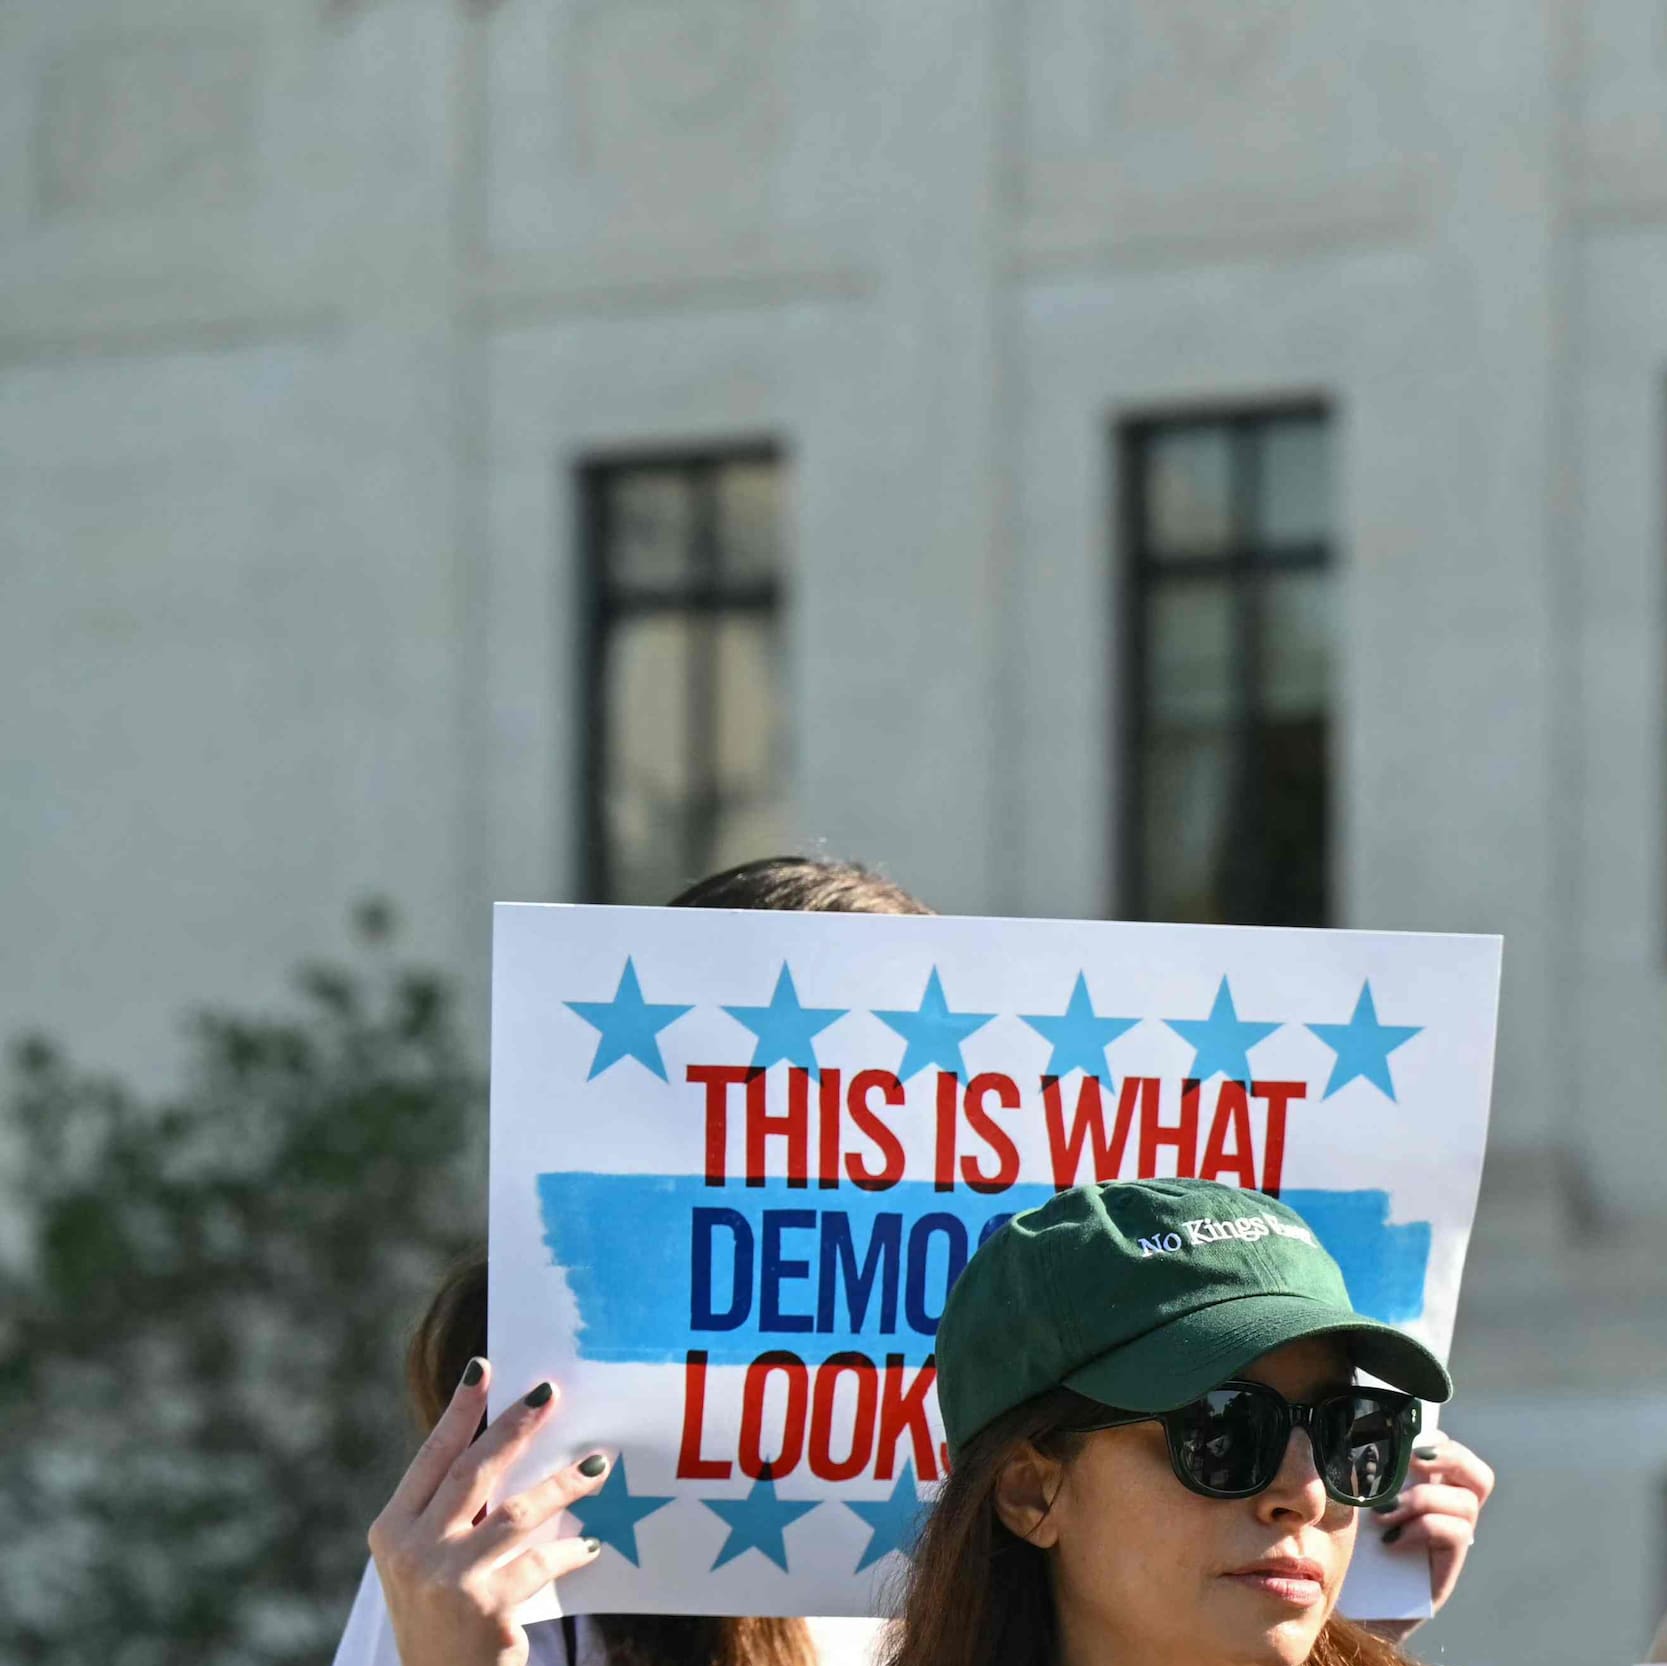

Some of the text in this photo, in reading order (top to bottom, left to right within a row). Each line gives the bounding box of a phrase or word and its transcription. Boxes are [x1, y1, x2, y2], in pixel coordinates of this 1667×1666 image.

[687, 1065, 1307, 1198] THIS IS WHAT
[690, 1207, 1014, 1336] DEMO
[1182, 1216, 1270, 1246] Kings
[681, 1350, 951, 1482] LOOK
